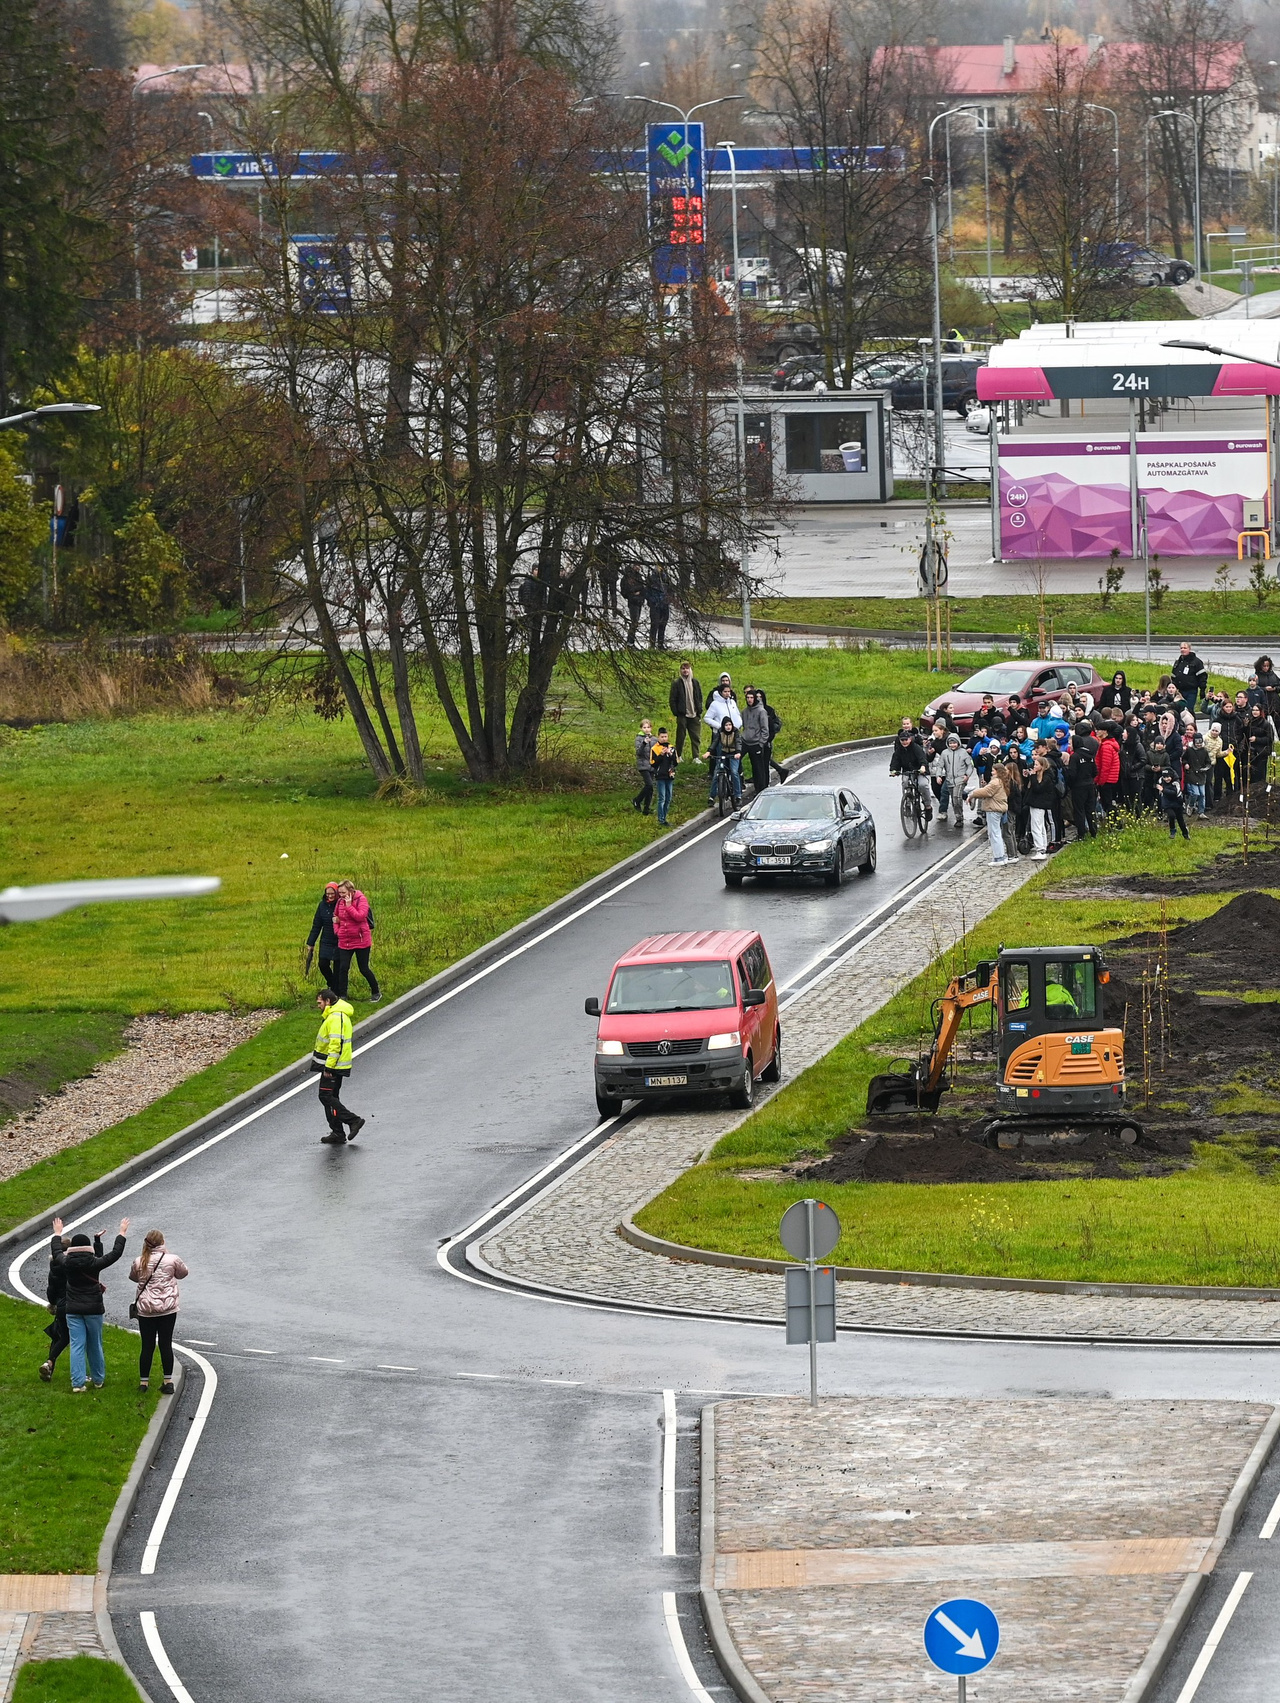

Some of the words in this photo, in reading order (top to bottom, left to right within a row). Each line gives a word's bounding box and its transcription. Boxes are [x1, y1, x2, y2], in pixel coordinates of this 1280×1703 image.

[1112, 372, 1150, 391] 24H
[1147, 461, 1217, 469] PAŠAPKALPOŠANĀS
[1147, 469, 1209, 477] AUTOMAZGĀTAVA
[1010, 493, 1025, 501] 24H
[760, 856, 790, 865] LT-3591
[972, 989, 989, 1001] CASE
[1064, 1034, 1096, 1044] CASE
[650, 1076, 686, 1085] MN-1137
